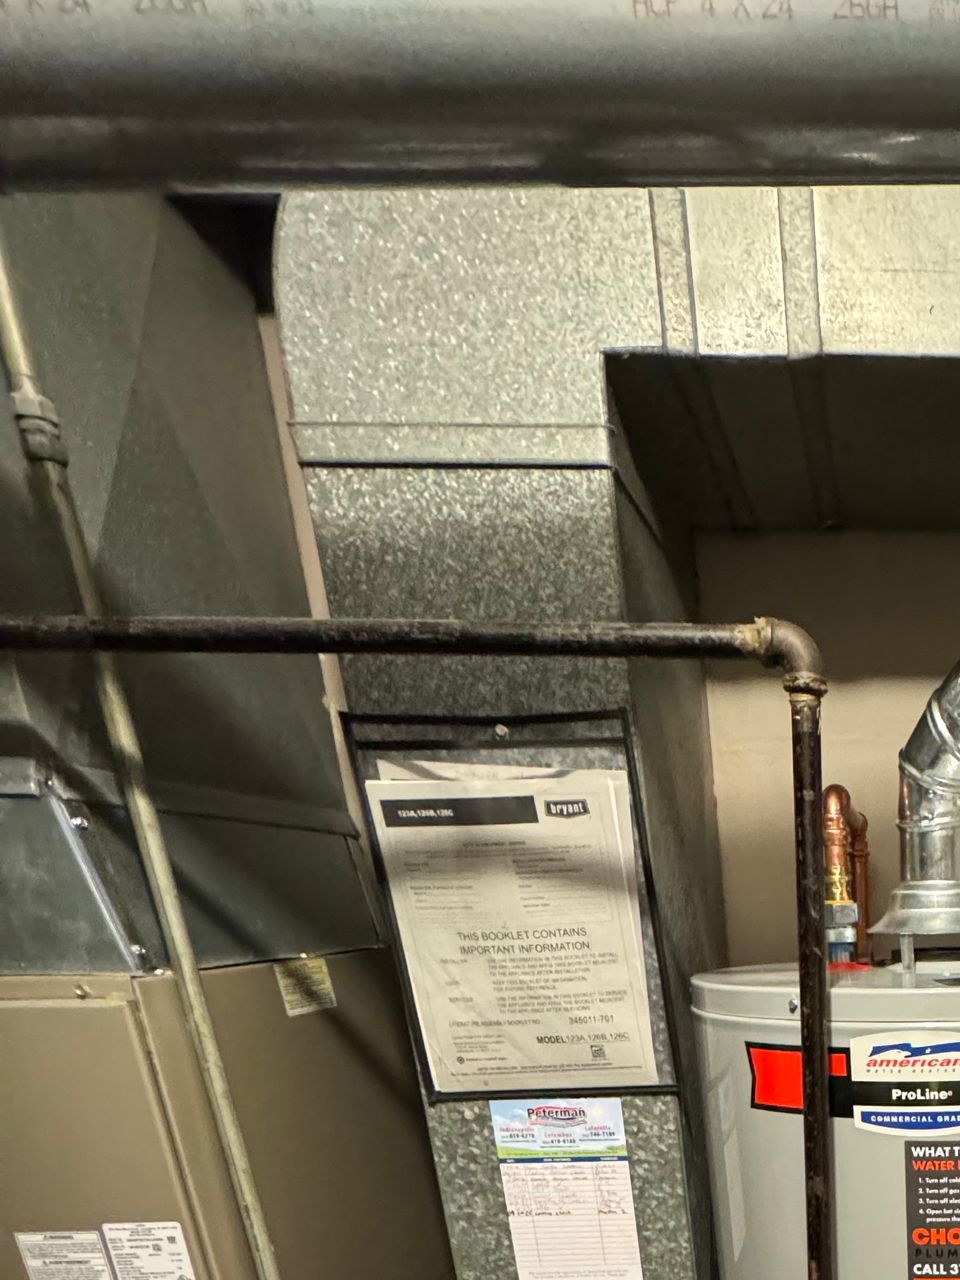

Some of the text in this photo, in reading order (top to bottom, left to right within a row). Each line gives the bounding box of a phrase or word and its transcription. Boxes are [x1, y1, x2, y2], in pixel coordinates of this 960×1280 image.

[550, 802, 584, 816] bryant
[457, 927, 588, 942] THIS BOOKLET CONTAINS
[459, 941, 591, 955] IMPORTANT INFORMATION
[536, 1035, 566, 1044] MODEL
[527, 1107, 586, 1120] Peterman
[870, 1115, 933, 1123] COMMERCIAL
[911, 1146, 952, 1157] WHAT
[912, 1160, 954, 1171] WATER
[913, 1263, 947, 1275] CALL
